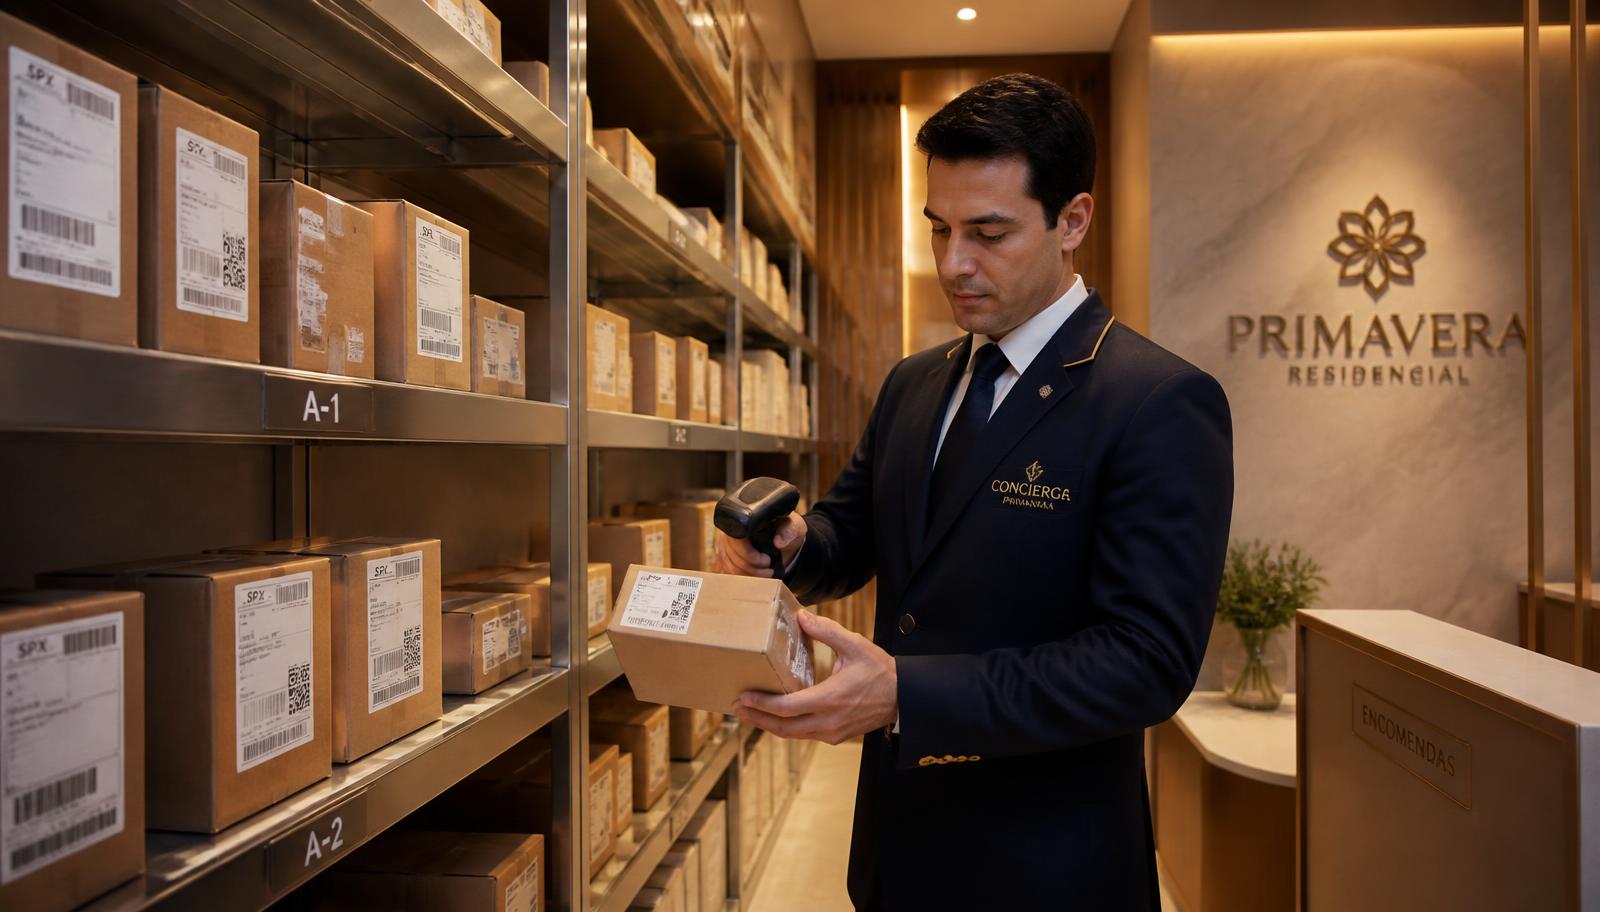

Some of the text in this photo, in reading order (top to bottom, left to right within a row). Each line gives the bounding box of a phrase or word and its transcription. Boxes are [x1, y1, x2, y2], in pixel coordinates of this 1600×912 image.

[1227, 313, 1527, 354] PRIMAVERA
[1287, 365, 1468, 385] RESIDENCIAL
[302, 391, 340, 423] A-1
[247, 590, 265, 603] SPX
[18, 638, 48, 659] SPX
[1362, 704, 1455, 777] ENCOMENDAS
[304, 816, 344, 867] A-2
